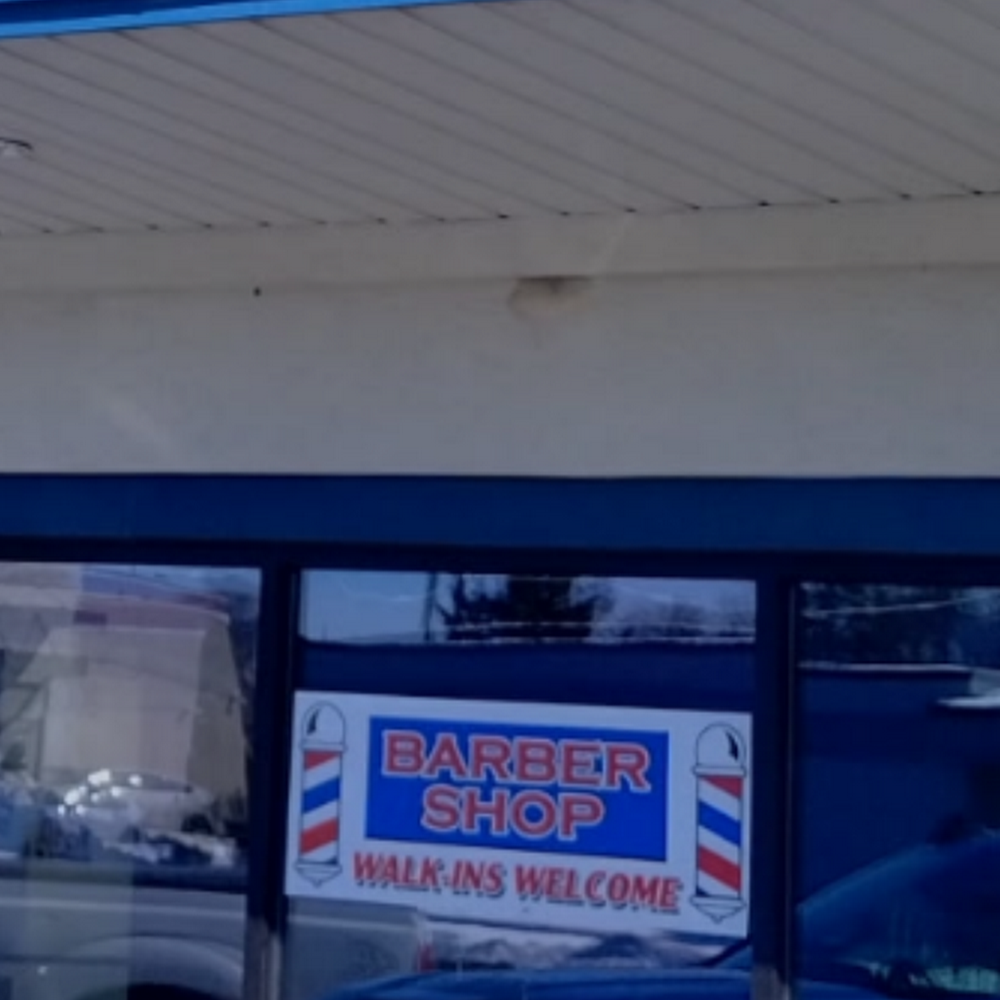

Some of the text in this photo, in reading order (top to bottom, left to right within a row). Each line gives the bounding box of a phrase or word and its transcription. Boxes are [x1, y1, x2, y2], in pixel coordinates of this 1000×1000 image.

[383, 730, 650, 791] BARBER
[422, 784, 605, 840] SHOP
[354, 853, 682, 914] WALK-INS WELCOME
